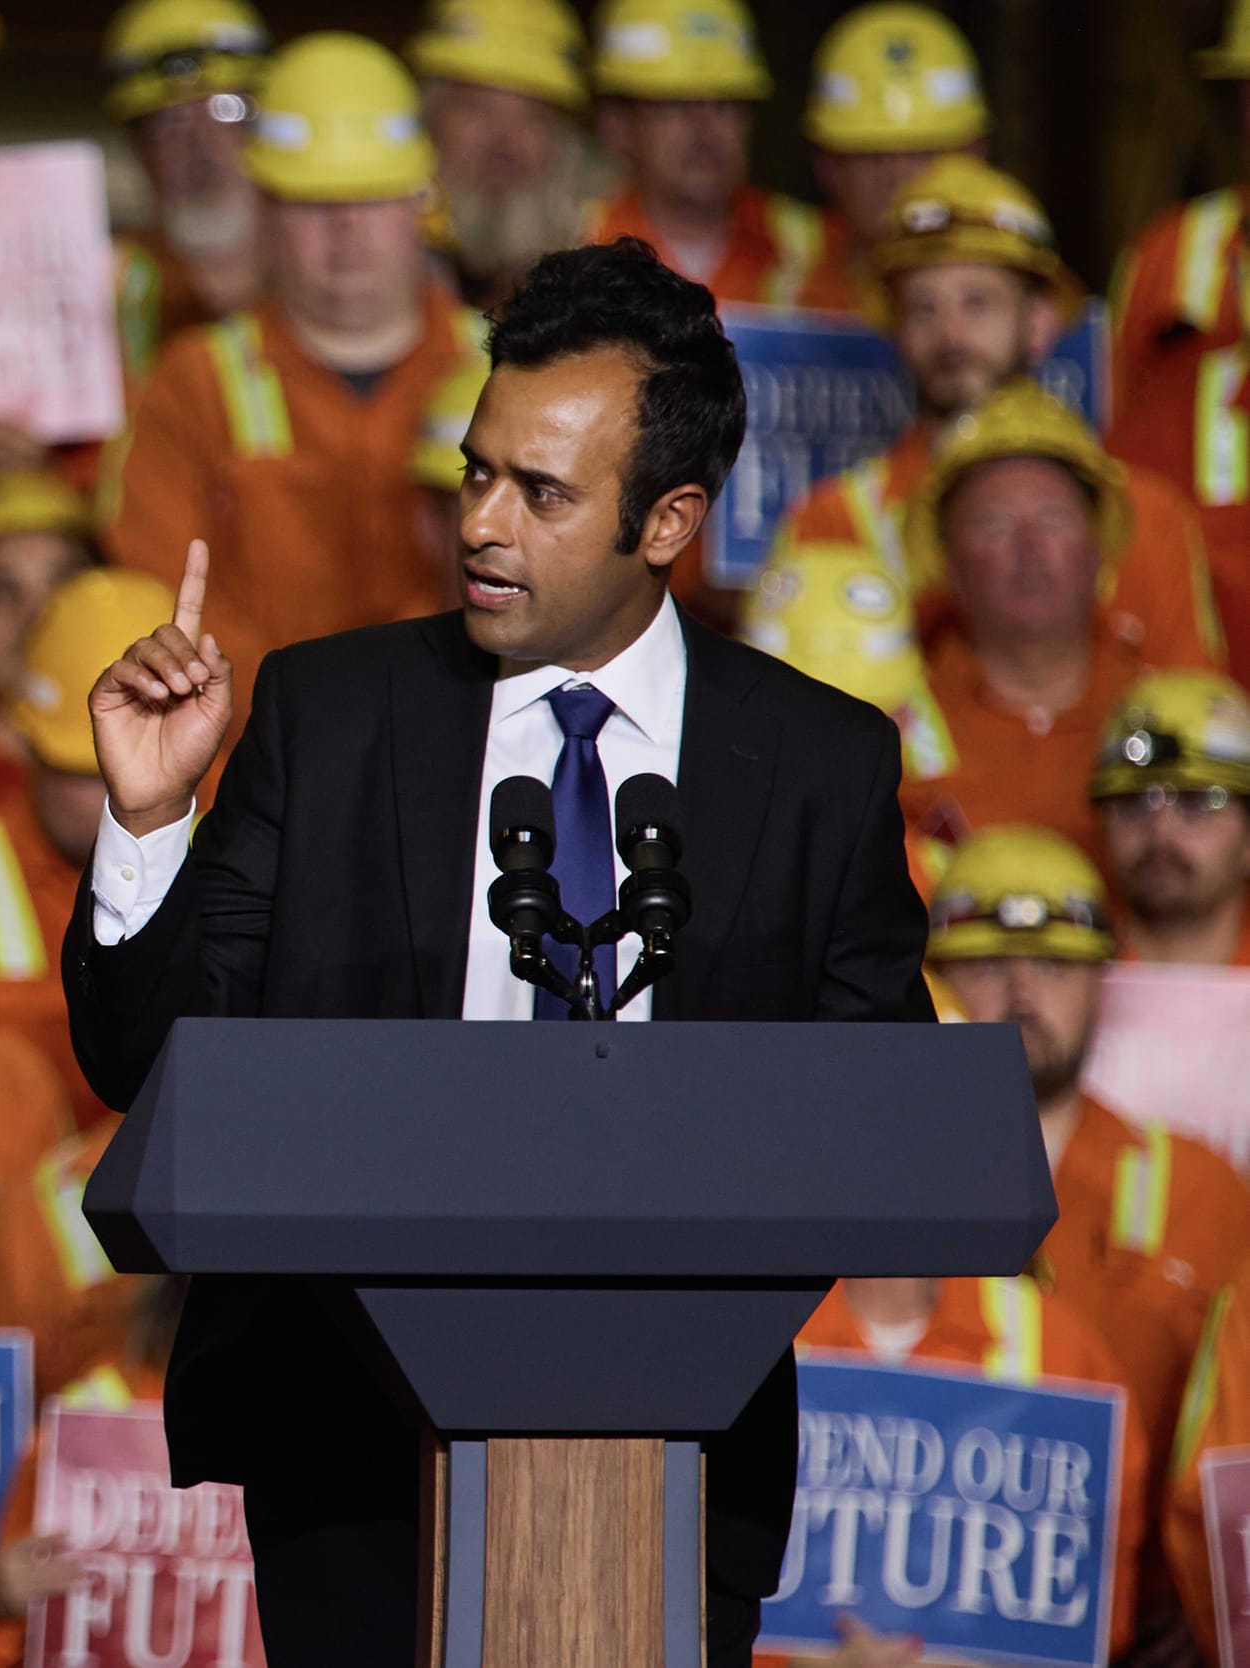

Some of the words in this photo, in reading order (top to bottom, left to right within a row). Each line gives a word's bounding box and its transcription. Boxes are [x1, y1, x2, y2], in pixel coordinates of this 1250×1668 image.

[70, 1469, 244, 1558] DEFE
[799, 1410, 945, 1497] END
[953, 1426, 1093, 1522] OUR
[62, 1553, 255, 1668] FUT
[760, 1487, 1091, 1628] TURE
